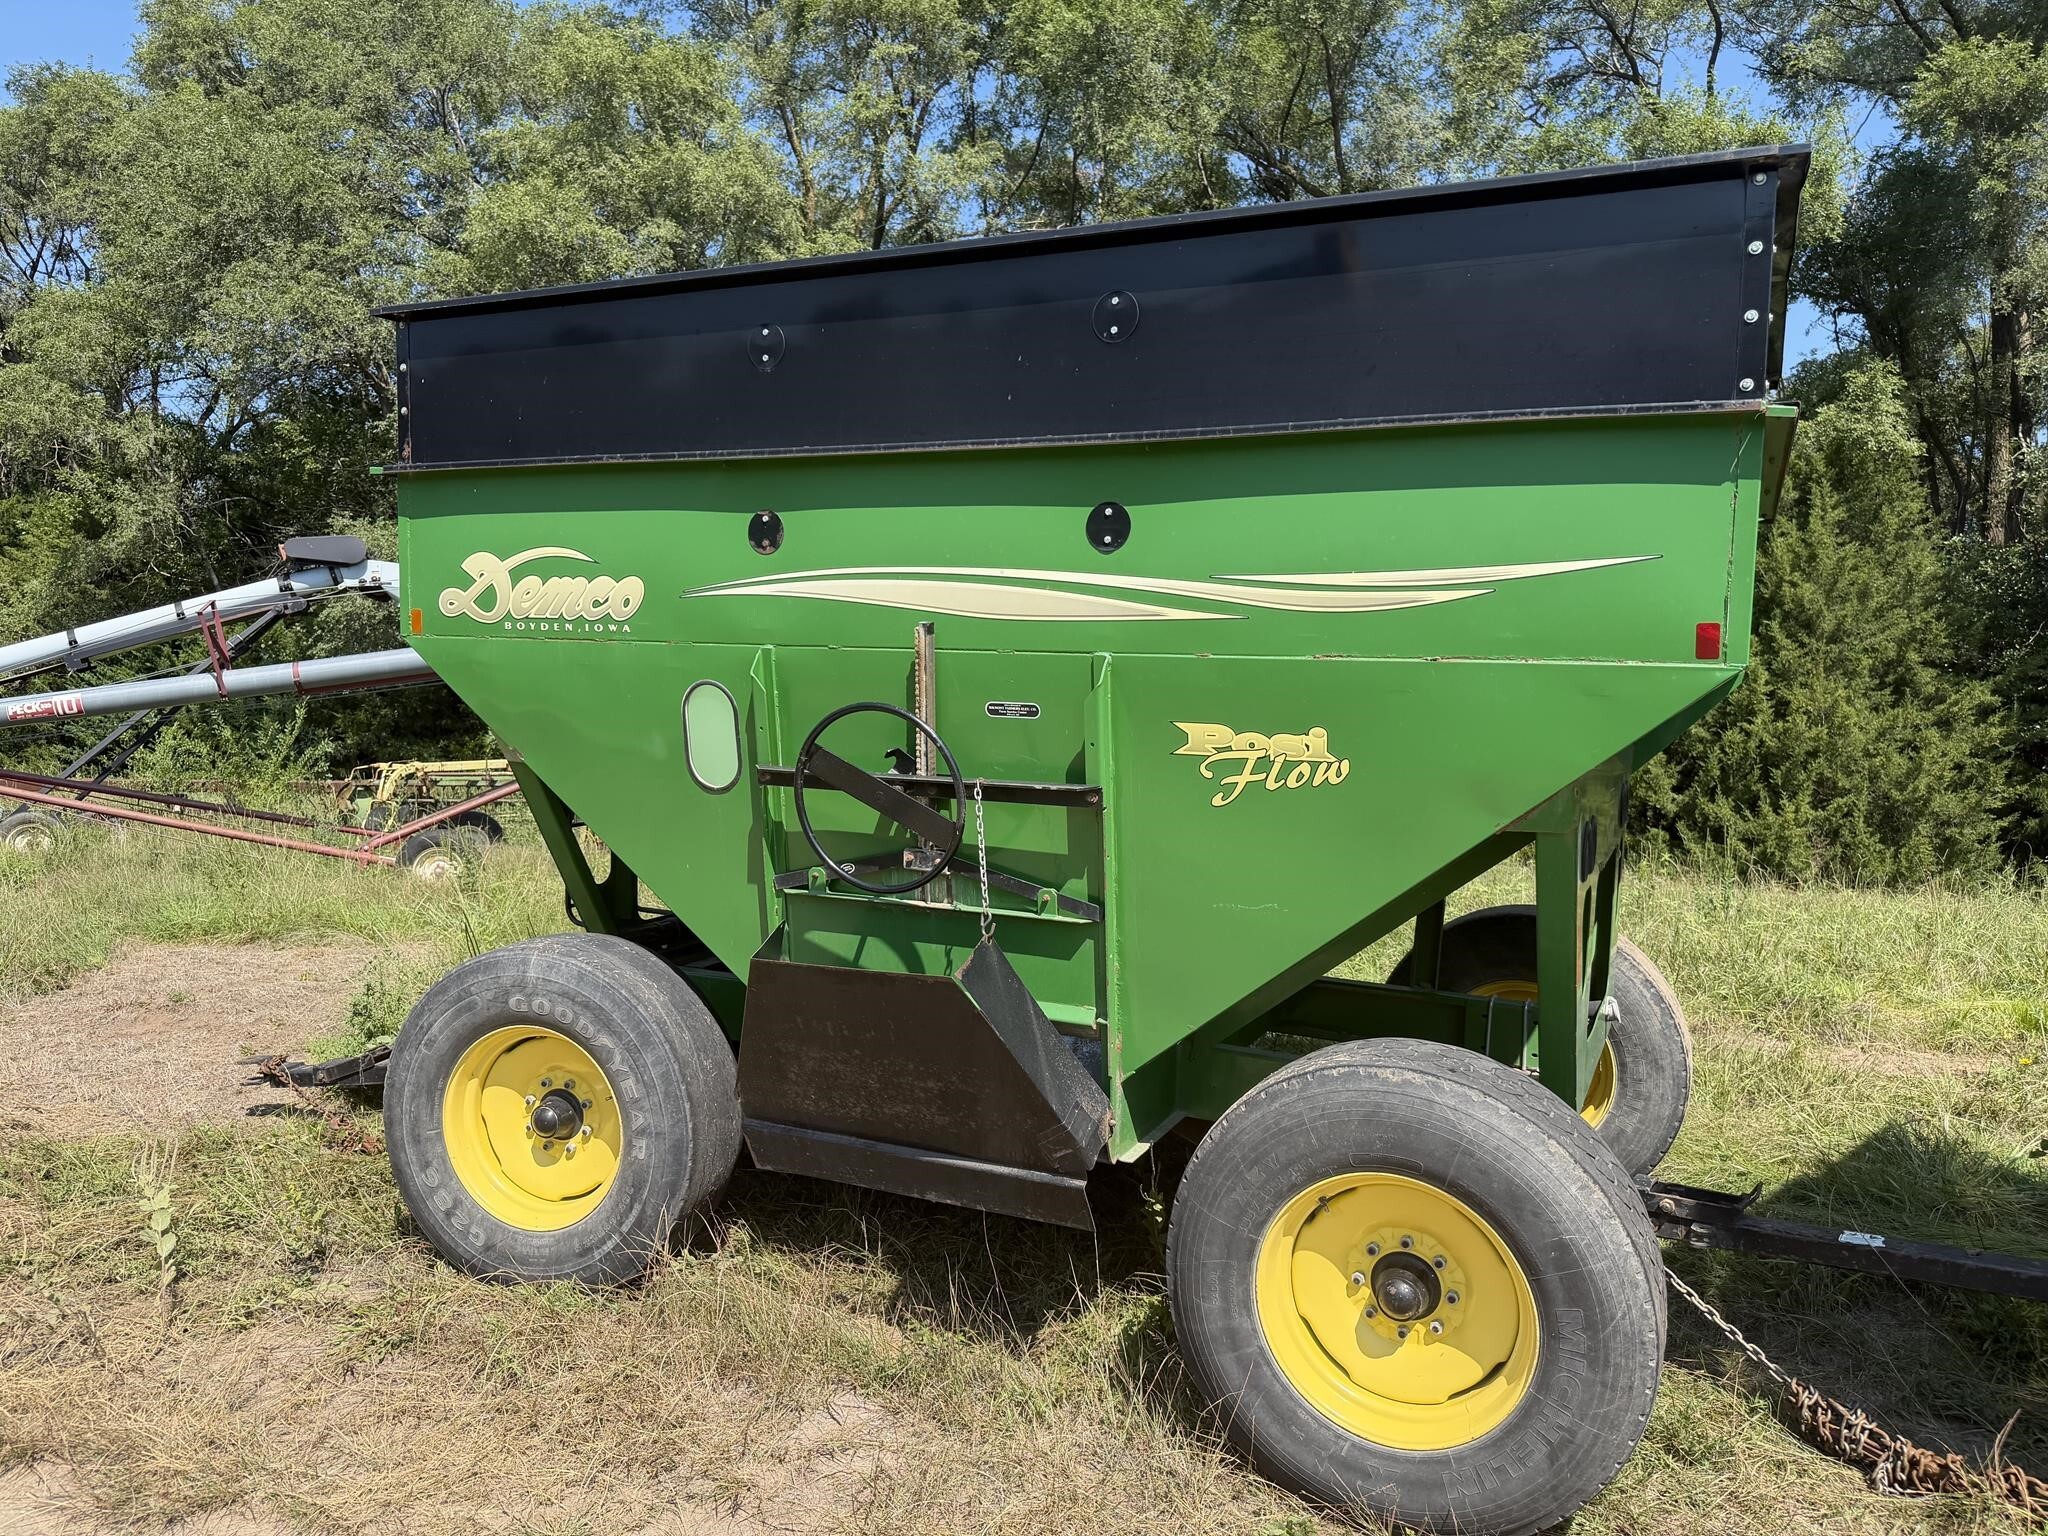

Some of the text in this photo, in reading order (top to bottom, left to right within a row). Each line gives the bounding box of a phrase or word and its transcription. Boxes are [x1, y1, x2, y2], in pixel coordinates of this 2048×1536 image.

[439, 546, 645, 624] Demco
[585, 623, 631, 633] IOWA
[8, 701, 42, 715] PECK
[1169, 721, 1341, 763] Posi
[1200, 748, 1350, 807] Flow
[508, 996, 649, 1161] GOODYEAR
[1441, 1308, 1586, 1499] MICHELIN
